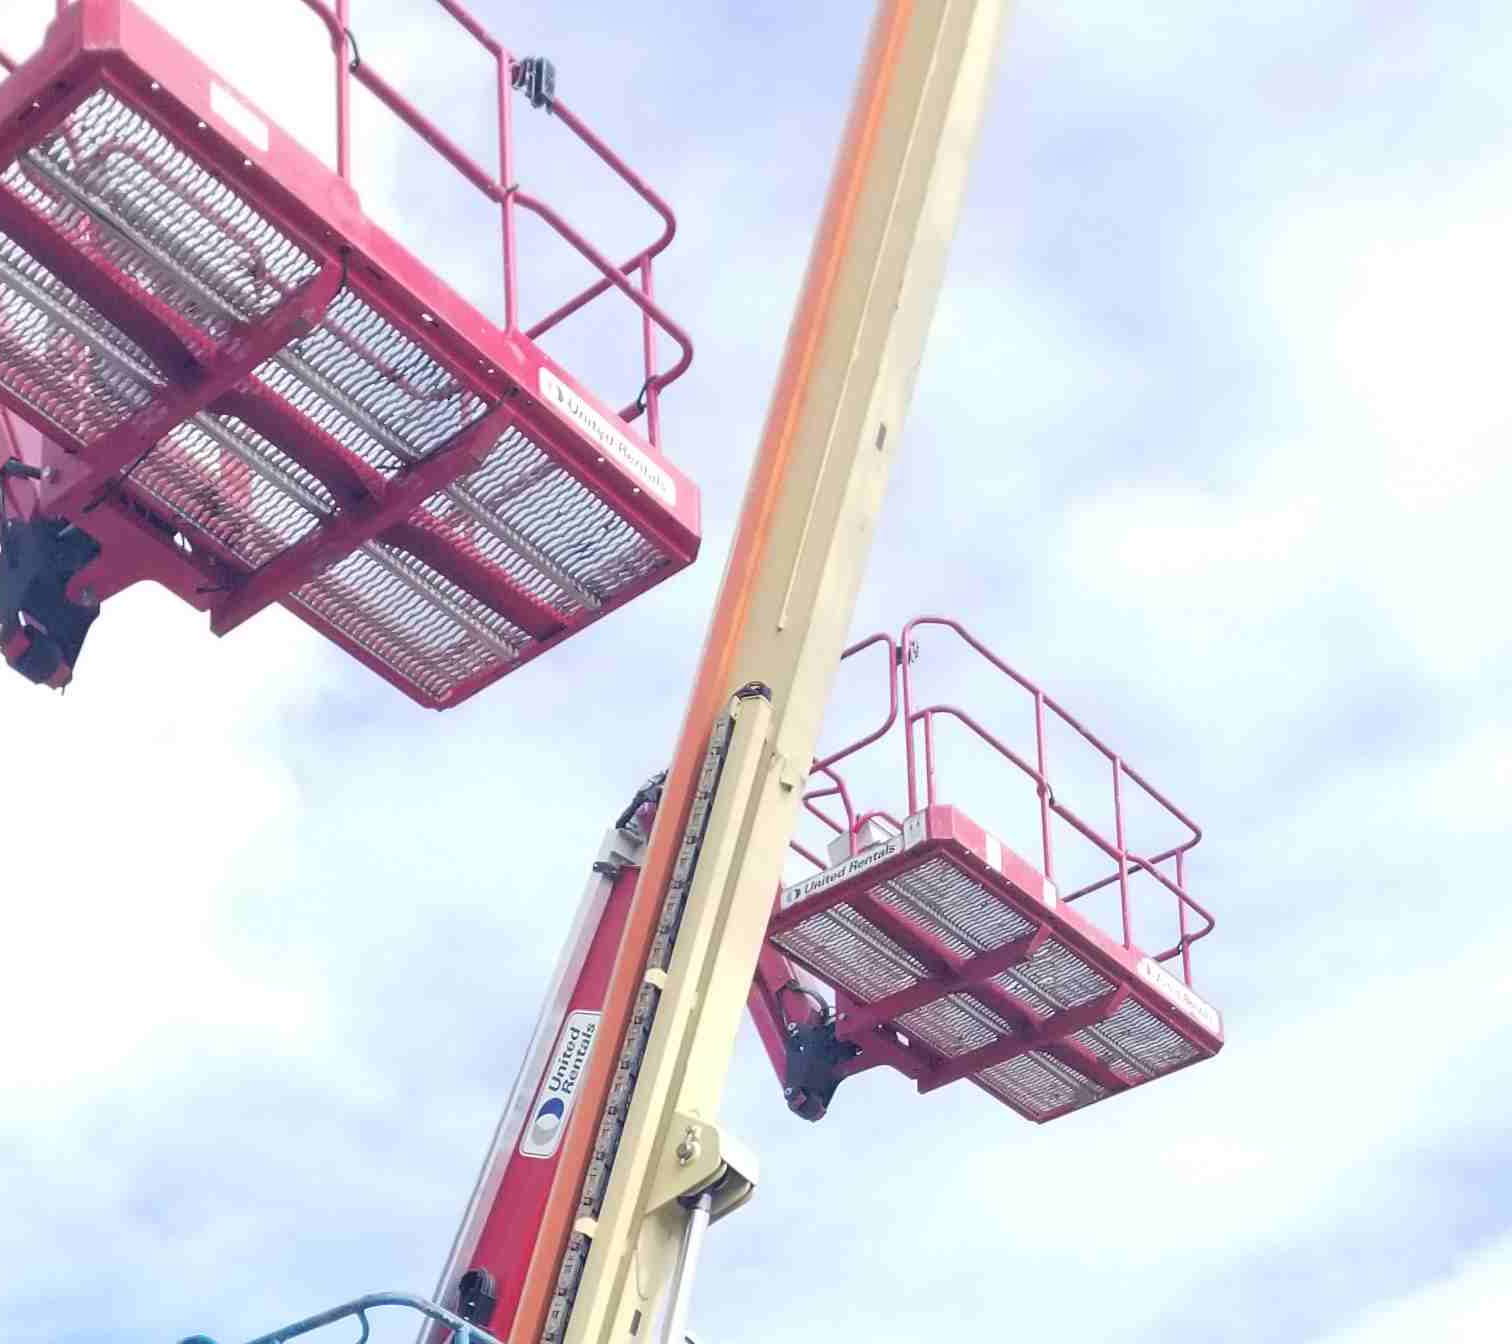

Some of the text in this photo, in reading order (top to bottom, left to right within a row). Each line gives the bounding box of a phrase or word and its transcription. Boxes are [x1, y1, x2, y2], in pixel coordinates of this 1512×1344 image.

[804, 846, 896, 894] United Rentals
[548, 1026, 581, 1093] United
[561, 1023, 596, 1095] Rentals
